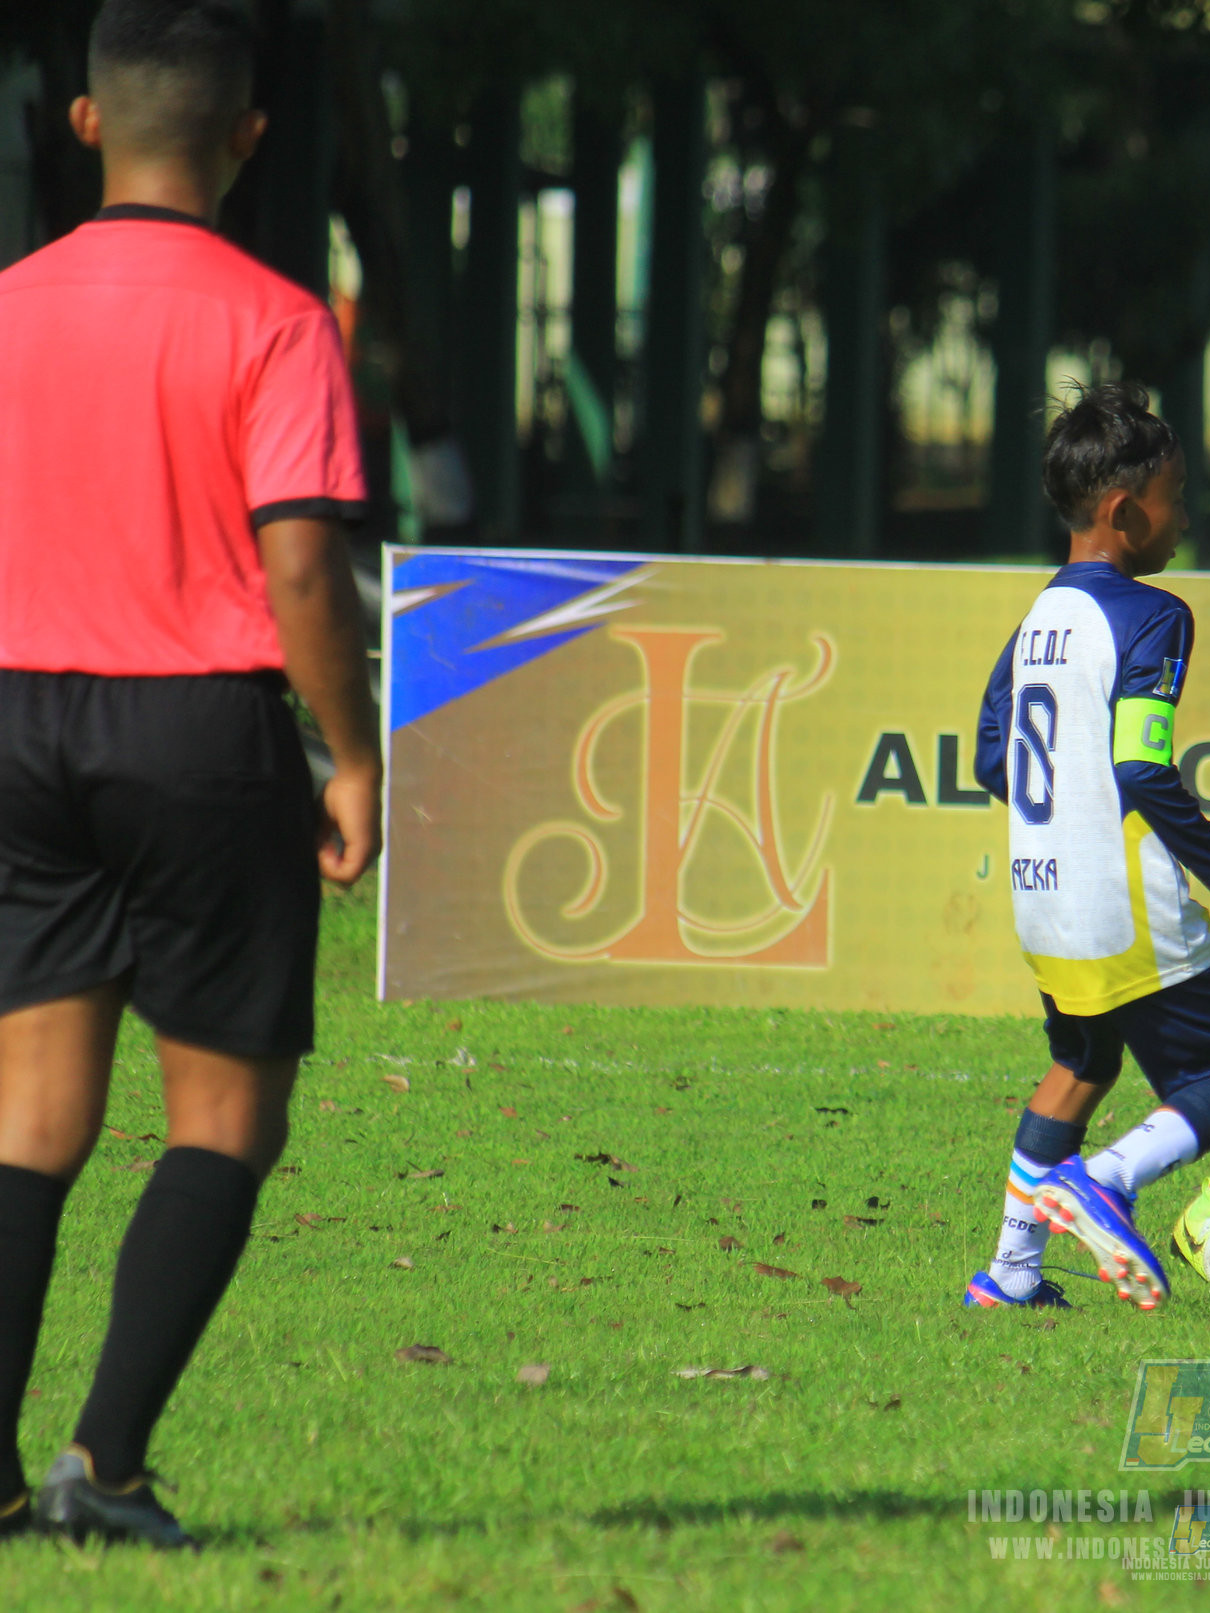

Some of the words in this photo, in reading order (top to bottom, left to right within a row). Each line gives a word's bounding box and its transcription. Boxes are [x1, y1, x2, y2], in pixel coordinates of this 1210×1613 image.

[1141, 713, 1169, 751] C
[1012, 683, 1058, 825] 8
[1011, 858, 1058, 891] AZKA
[1003, 1215, 1038, 1234] FCDC
